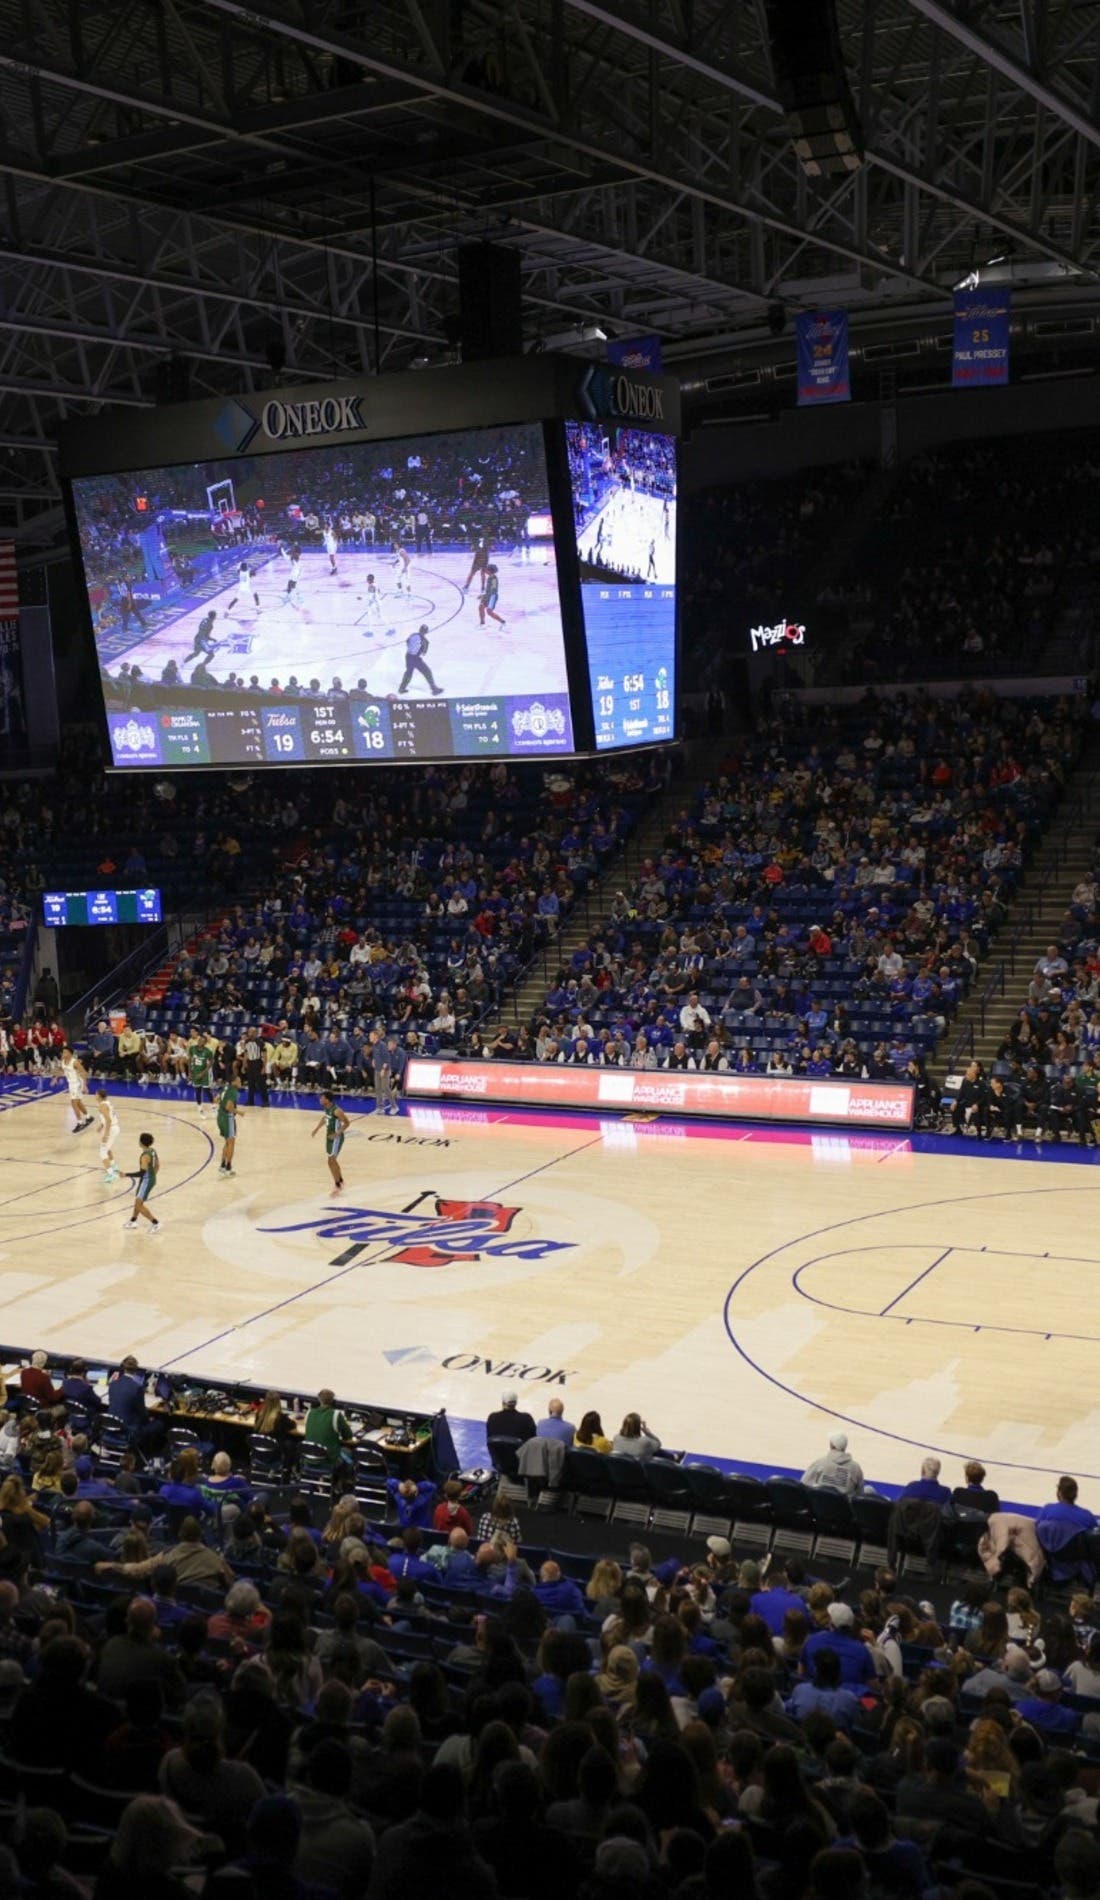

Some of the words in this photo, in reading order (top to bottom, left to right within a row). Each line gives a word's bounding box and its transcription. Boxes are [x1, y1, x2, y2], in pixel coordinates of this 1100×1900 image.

[972, 329, 990, 344] 25
[955, 351, 973, 361] PAUL
[617, 376, 663, 419] ONEOK
[262, 396, 362, 438] ONEOK
[750, 619, 806, 652] Mazzio's
[623, 674, 644, 692] 6:54
[600, 695, 613, 716] 19
[656, 690, 669, 709] 18
[314, 706, 334, 718] 1ST
[266, 713, 297, 728] Tulsa
[491, 721, 498, 730] 4
[273, 734, 294, 752] 19
[310, 730, 345, 744] 6:54
[362, 731, 384, 749] 18
[492, 734, 499, 743] 4
[194, 744, 200, 753] 4
[92, 906, 112, 914] 6:54
[440, 1073, 487, 1084] APPLIANCE
[634, 1085, 685, 1097] APPLIANCE
[849, 1098, 908, 1110] APPLIANCE
[847, 1108, 907, 1120] WAREHOUSE
[367, 1133, 459, 1148] ONEOK
[256, 1206, 579, 1260] Tulsa
[441, 1353, 579, 1386] ONEOK
